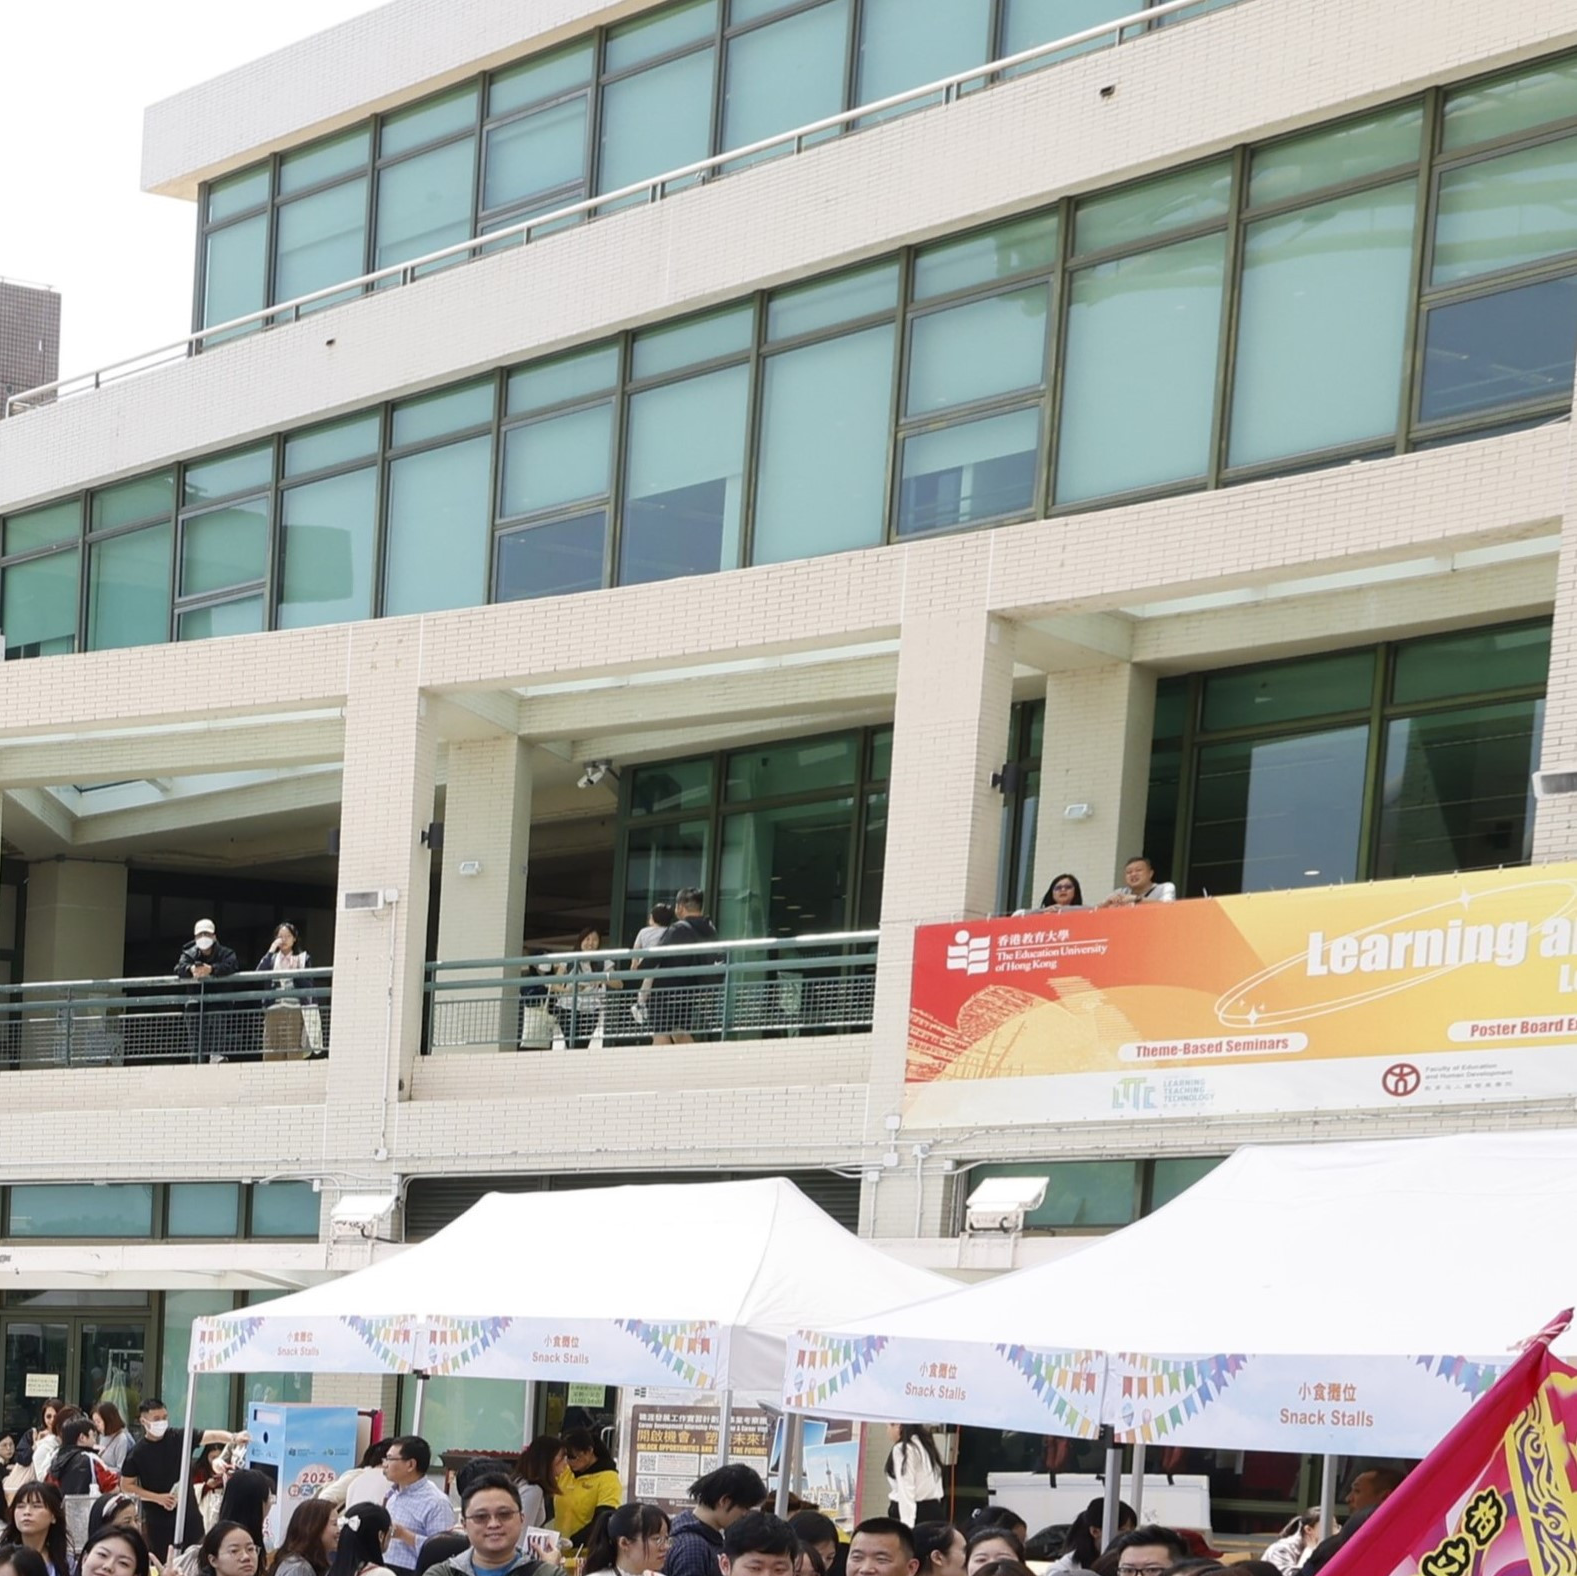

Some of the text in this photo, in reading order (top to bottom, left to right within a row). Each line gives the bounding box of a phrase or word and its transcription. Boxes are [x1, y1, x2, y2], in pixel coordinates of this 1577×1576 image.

[997, 929, 1070, 946] 香港教育大學
[996, 944, 1108, 961] The Education University
[1307, 920, 1528, 976] Learning
[995, 959, 1057, 973] of Hong Kong
[1470, 1022, 1516, 1038] Poster
[1520, 1018, 1563, 1034] Board
[1136, 1037, 1289, 1058] Theme-Based Seminars
[277, 1346, 320, 1356] Snack Stalls
[532, 1351, 590, 1365] Snack Stalls
[919, 1361, 959, 1380] 小食攤位
[904, 1382, 967, 1401] Snack Stalls
[1298, 1382, 1357, 1403] 小食攤位
[1280, 1407, 1375, 1427] Snack Stalls
[302, 1472, 334, 1483] 2025
